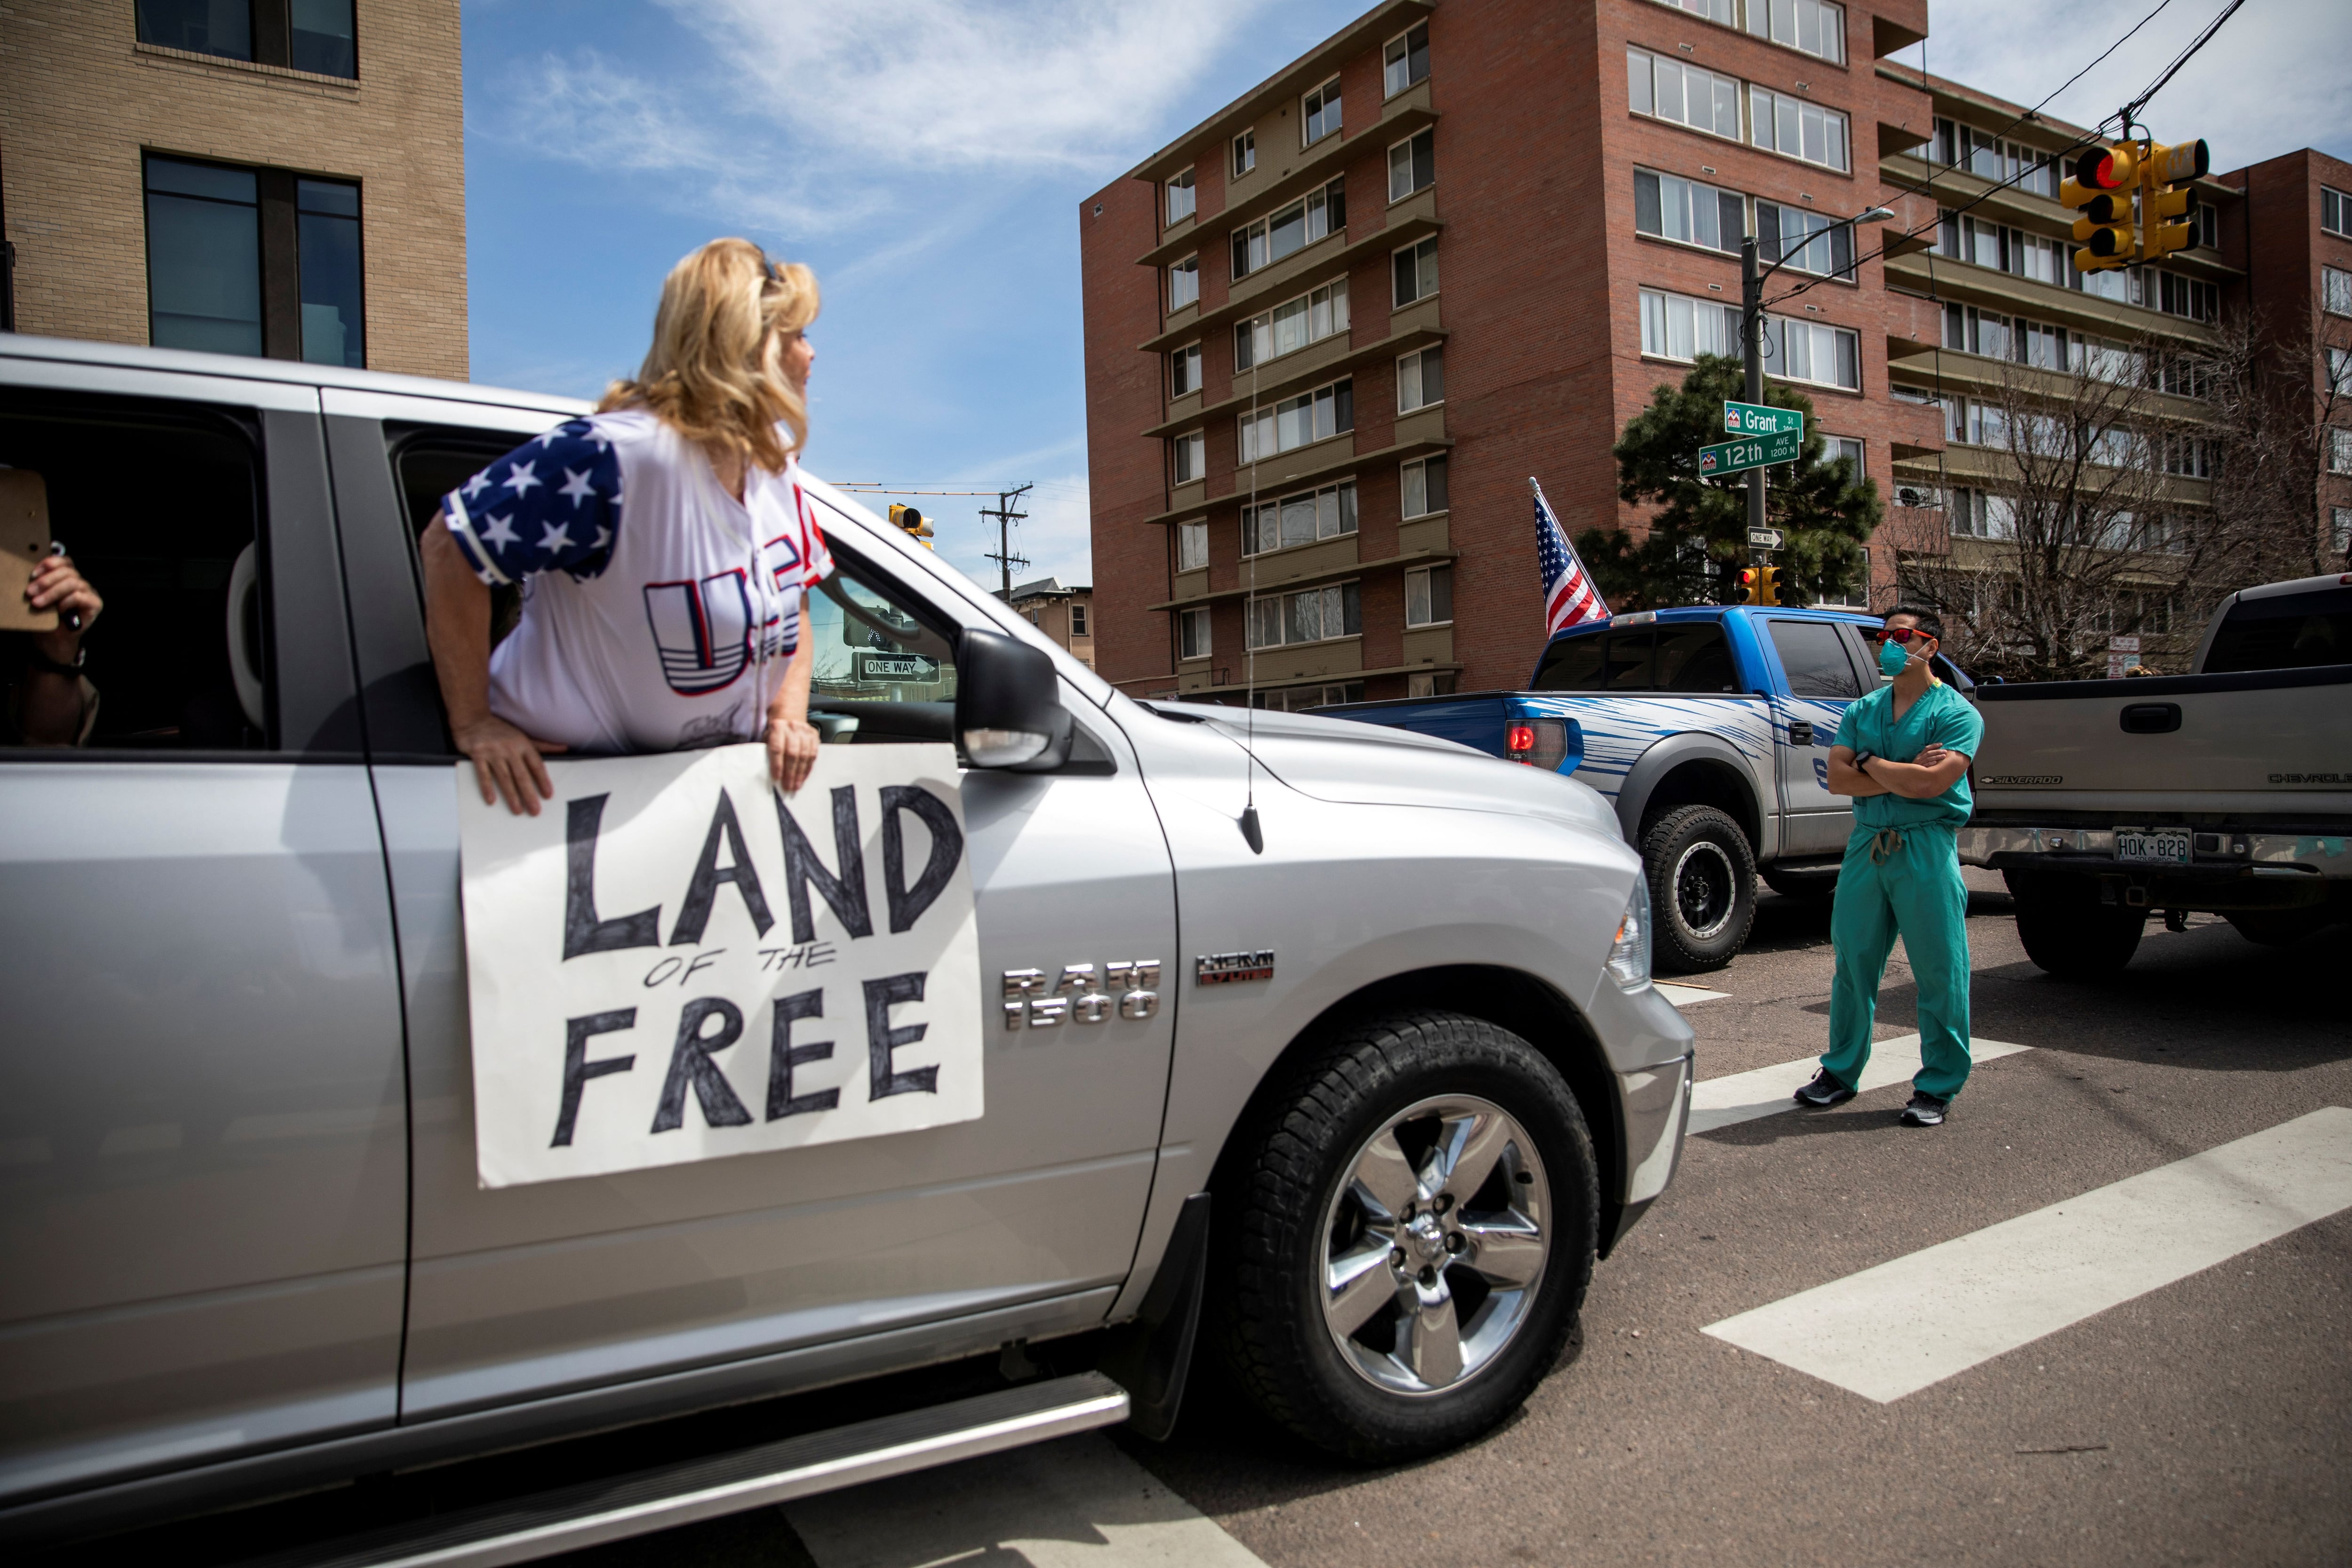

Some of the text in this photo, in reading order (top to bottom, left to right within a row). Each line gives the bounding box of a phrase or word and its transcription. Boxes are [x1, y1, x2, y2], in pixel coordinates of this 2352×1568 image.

[1746, 410, 1777, 432] Grant
[1725, 437, 1789, 466] 12th AVE
[1771, 447, 1787, 457] 1200
[868, 662, 915, 673] ONE WAY
[562, 784, 963, 962] LAND
[643, 942, 837, 987] OF THE
[1196, 949, 1274, 972] HEMI
[1002, 959, 1160, 998] RAM
[1002, 990, 1160, 1030] 1500
[549, 971, 940, 1148] FREE
